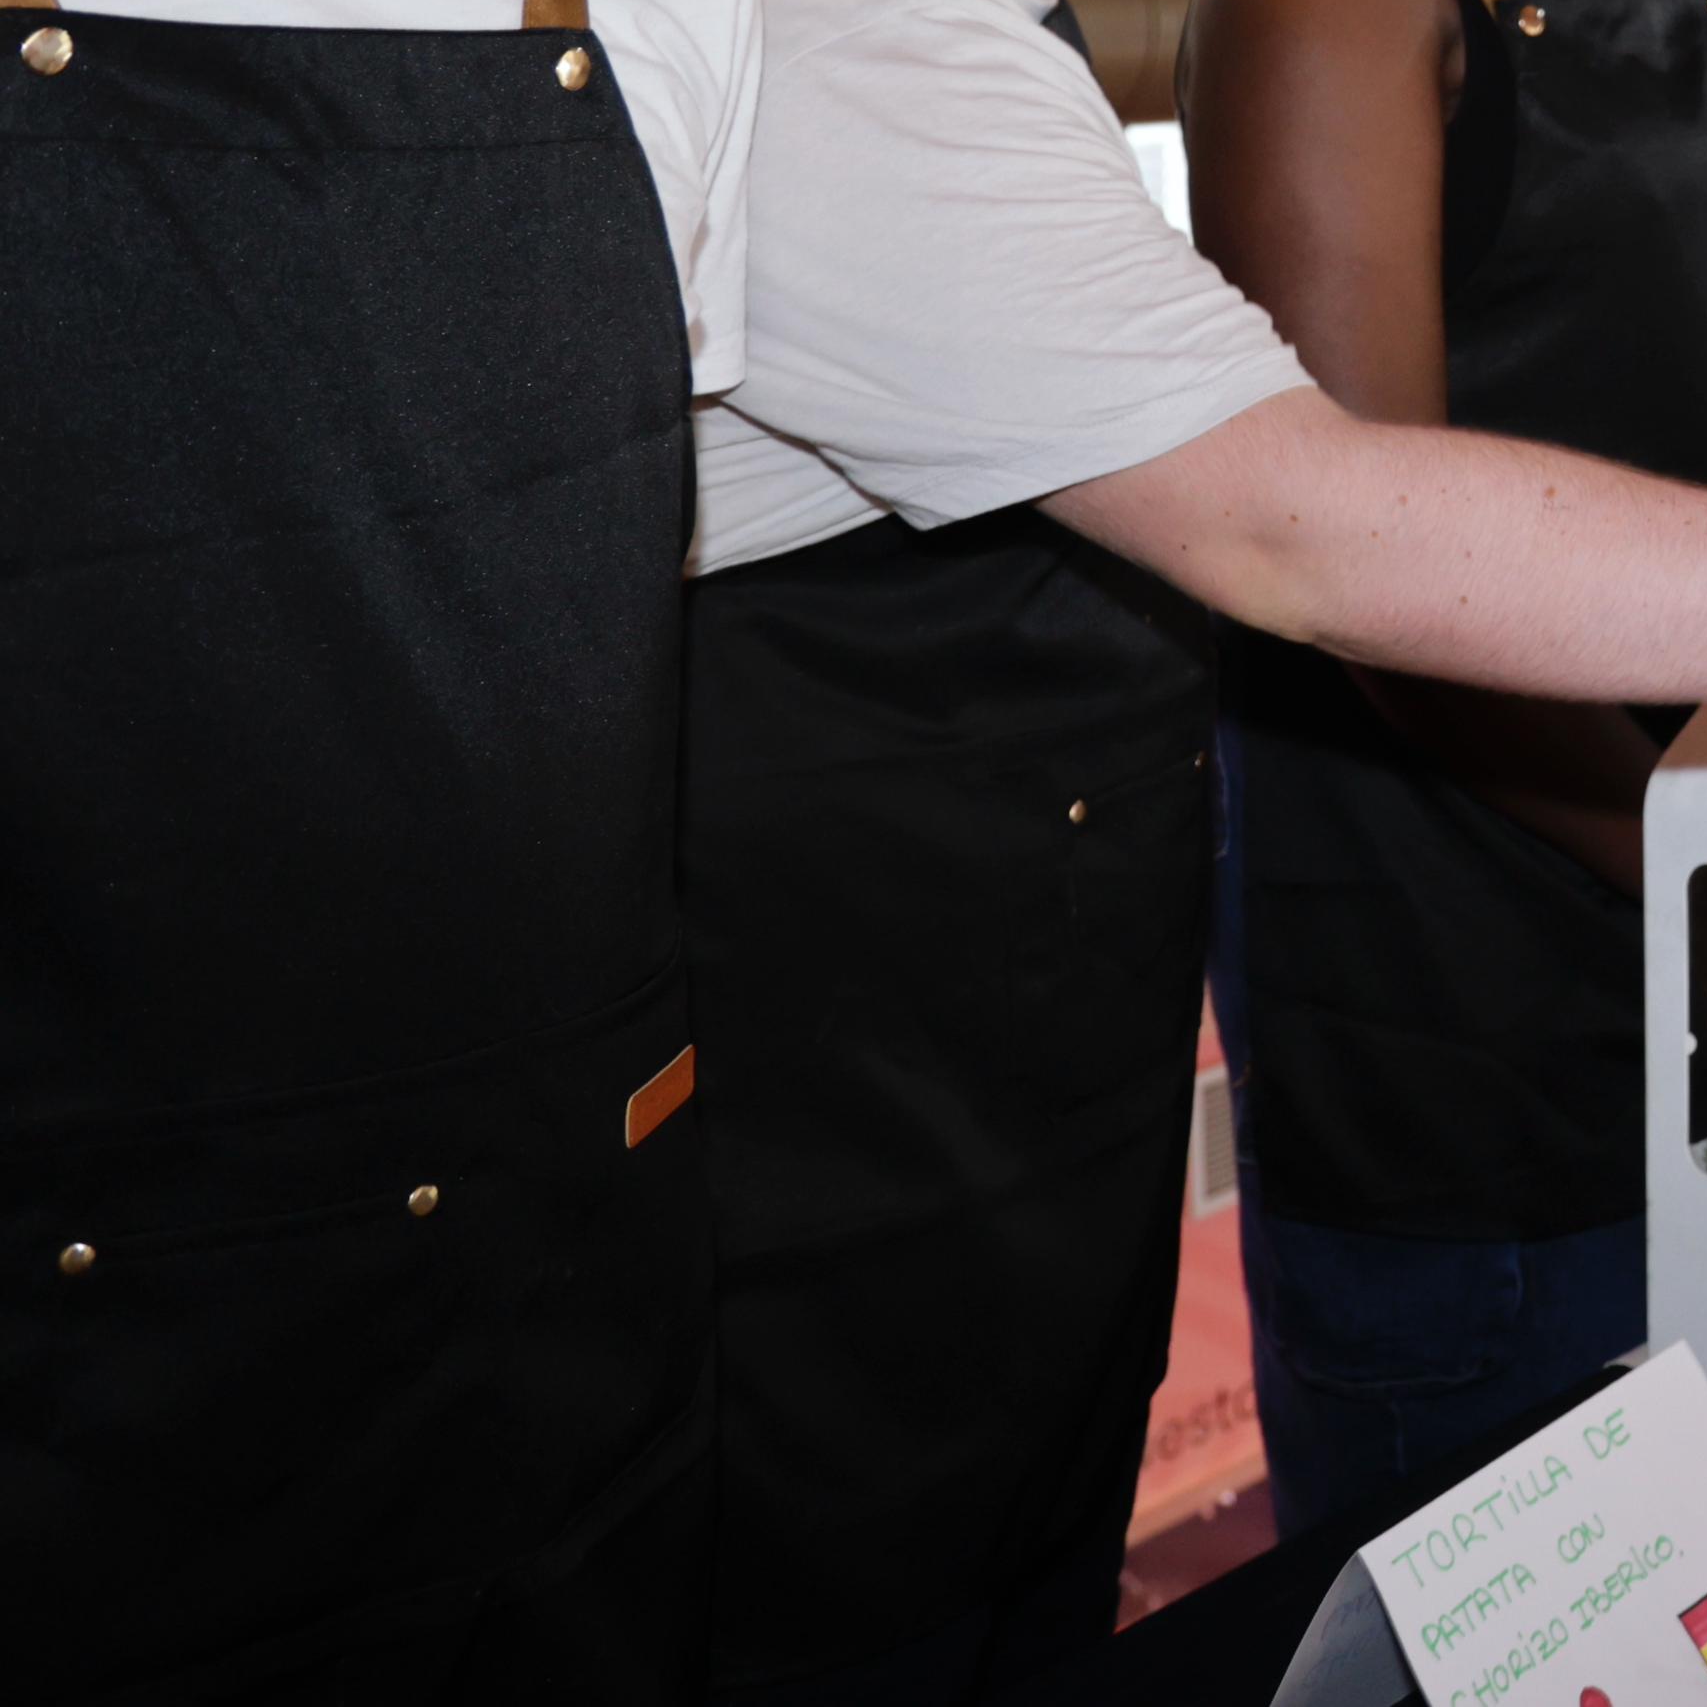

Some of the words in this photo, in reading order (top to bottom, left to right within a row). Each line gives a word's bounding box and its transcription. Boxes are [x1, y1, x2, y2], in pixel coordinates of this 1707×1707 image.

[1390, 1454, 1574, 1589] TORTILLA
[1582, 1407, 1632, 1461] DE
[1420, 1561, 1538, 1662] PATATA
[1556, 1511, 1606, 1564] CON
